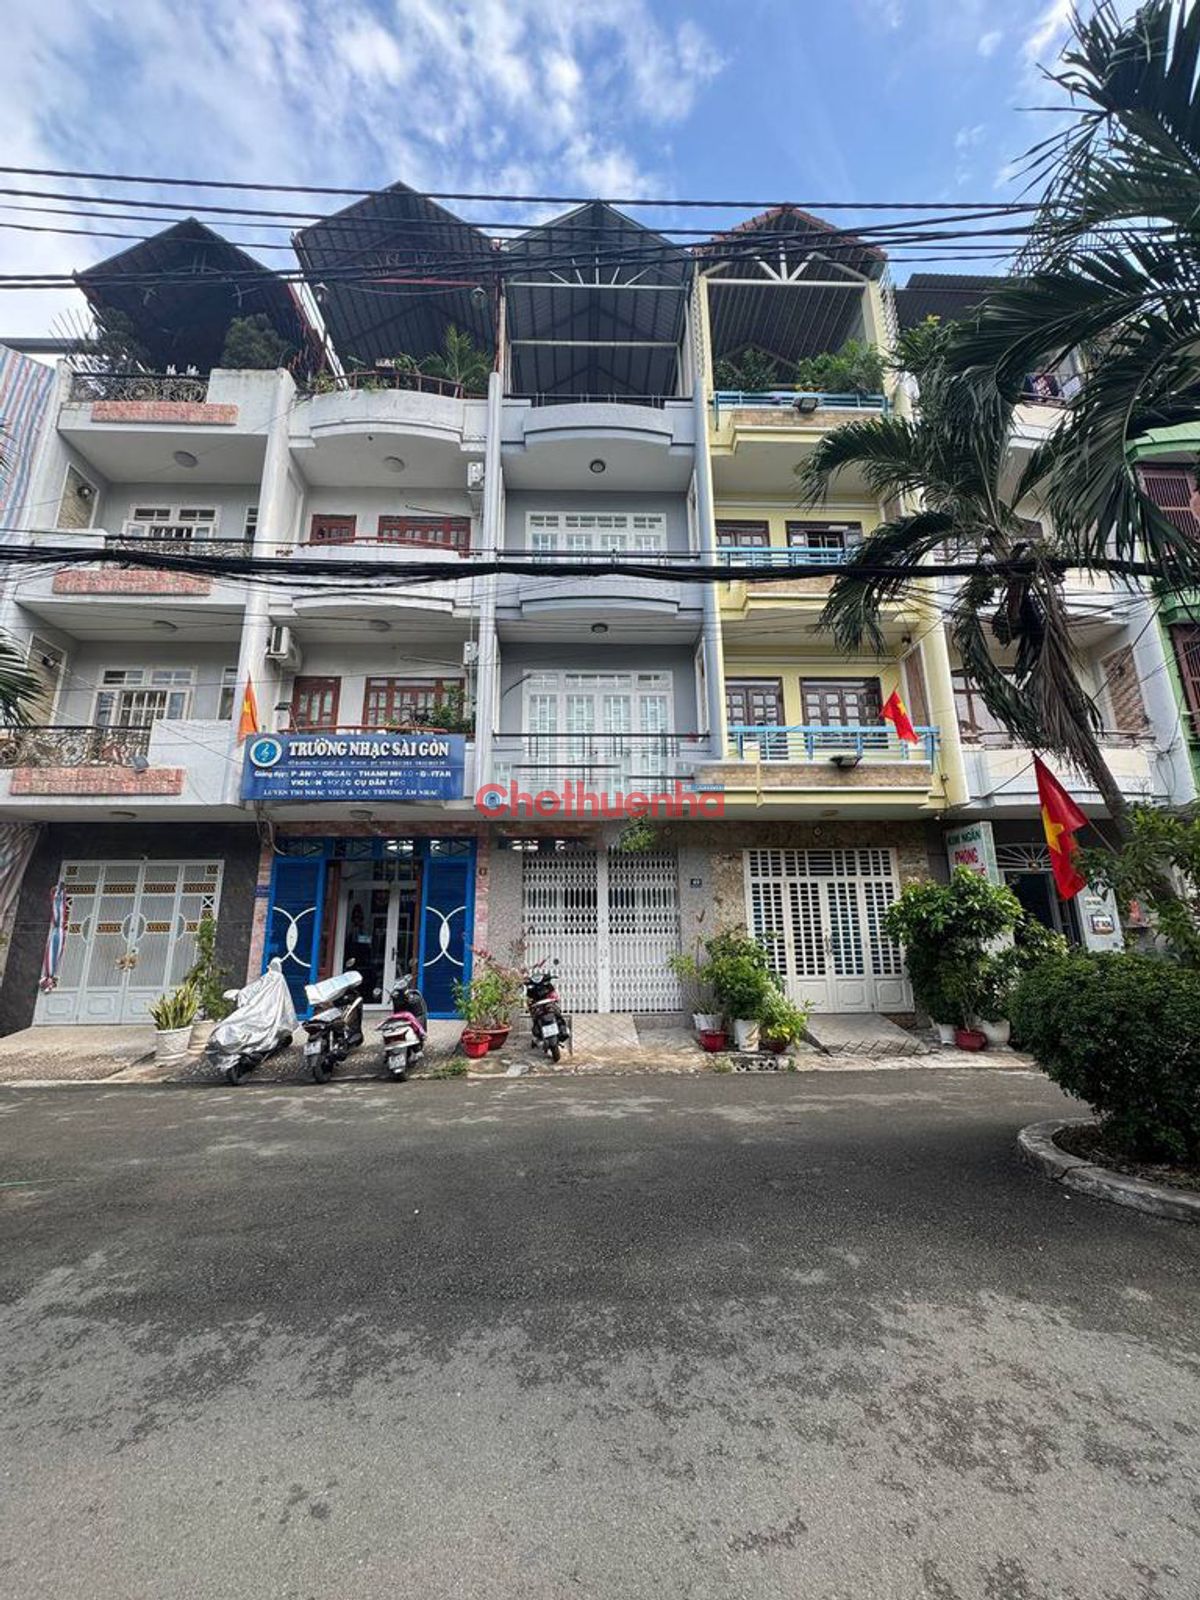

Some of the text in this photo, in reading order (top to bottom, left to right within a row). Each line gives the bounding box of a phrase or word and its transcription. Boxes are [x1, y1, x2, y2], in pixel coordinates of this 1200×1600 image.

[288, 738, 450, 759] TRƯỜNG NHẠC SÀI GÒN
[290, 770, 317, 778] PANO
[419, 770, 451, 778] GITAR
